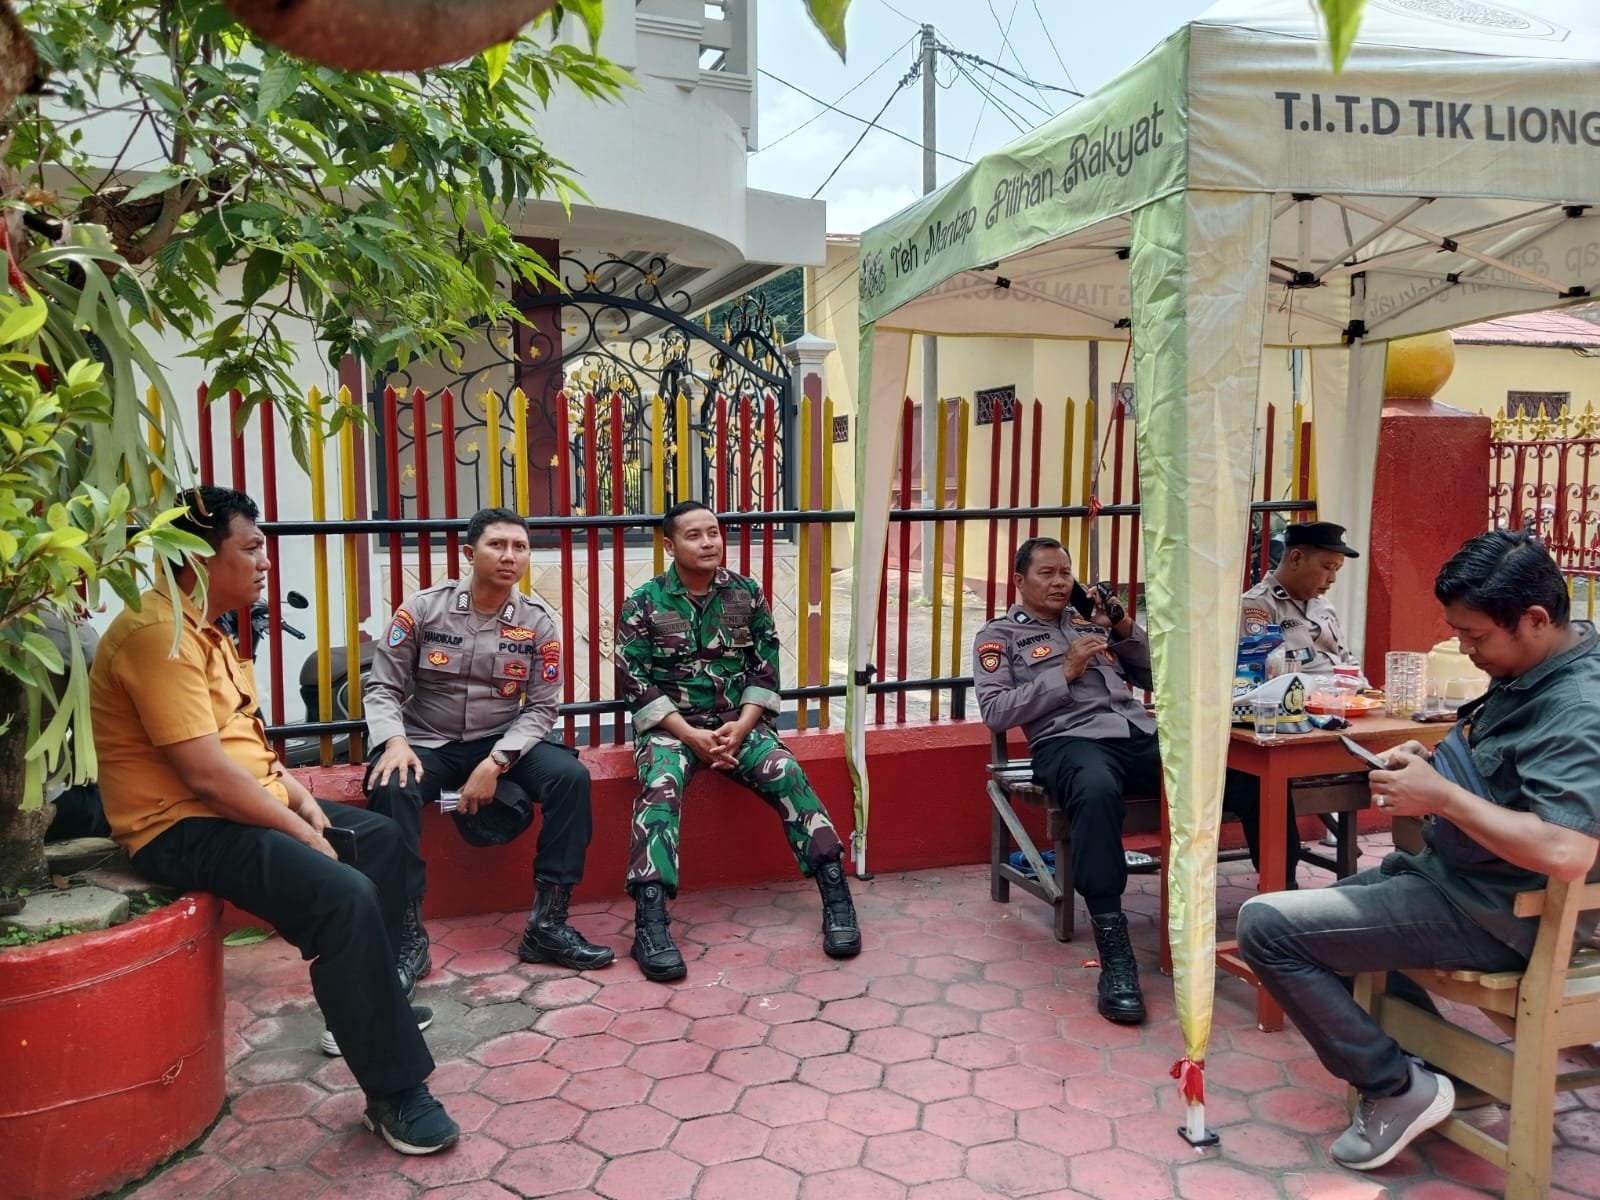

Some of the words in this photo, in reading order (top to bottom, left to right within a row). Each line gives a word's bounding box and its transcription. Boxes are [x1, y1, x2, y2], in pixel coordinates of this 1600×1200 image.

[1274, 91, 1401, 136] T.I.T.D
[1408, 99, 1474, 140] TIK
[1484, 104, 1600, 147] LIONG
[891, 239, 918, 278] Teh
[924, 205, 977, 265] Mantap
[985, 167, 1053, 230] Pilihan
[1062, 101, 1165, 195] Rakyat
